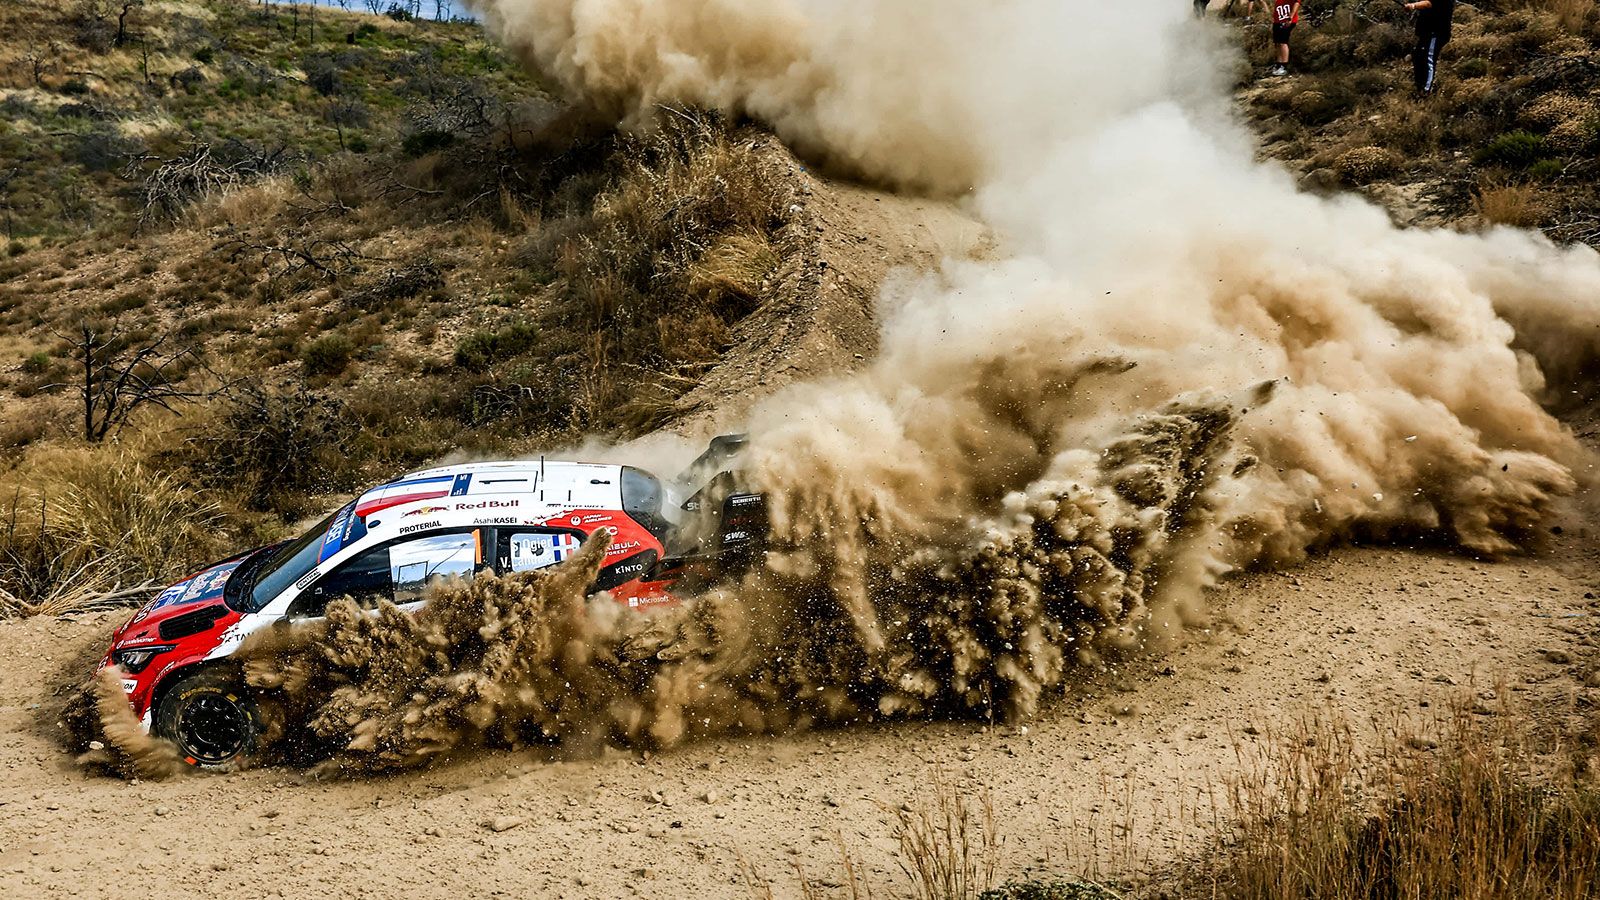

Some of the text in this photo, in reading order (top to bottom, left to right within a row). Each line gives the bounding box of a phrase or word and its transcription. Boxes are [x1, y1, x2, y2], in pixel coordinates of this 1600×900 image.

[455, 500, 519, 510] Red Bull
[473, 517, 517, 525] AsahiKASEI
[399, 520, 442, 534] PROTERIAL
[522, 538, 552, 553] Ogier
[500, 556, 511, 568] V.
[615, 563, 643, 574] KINTO
[639, 595, 669, 605] Microsoft
